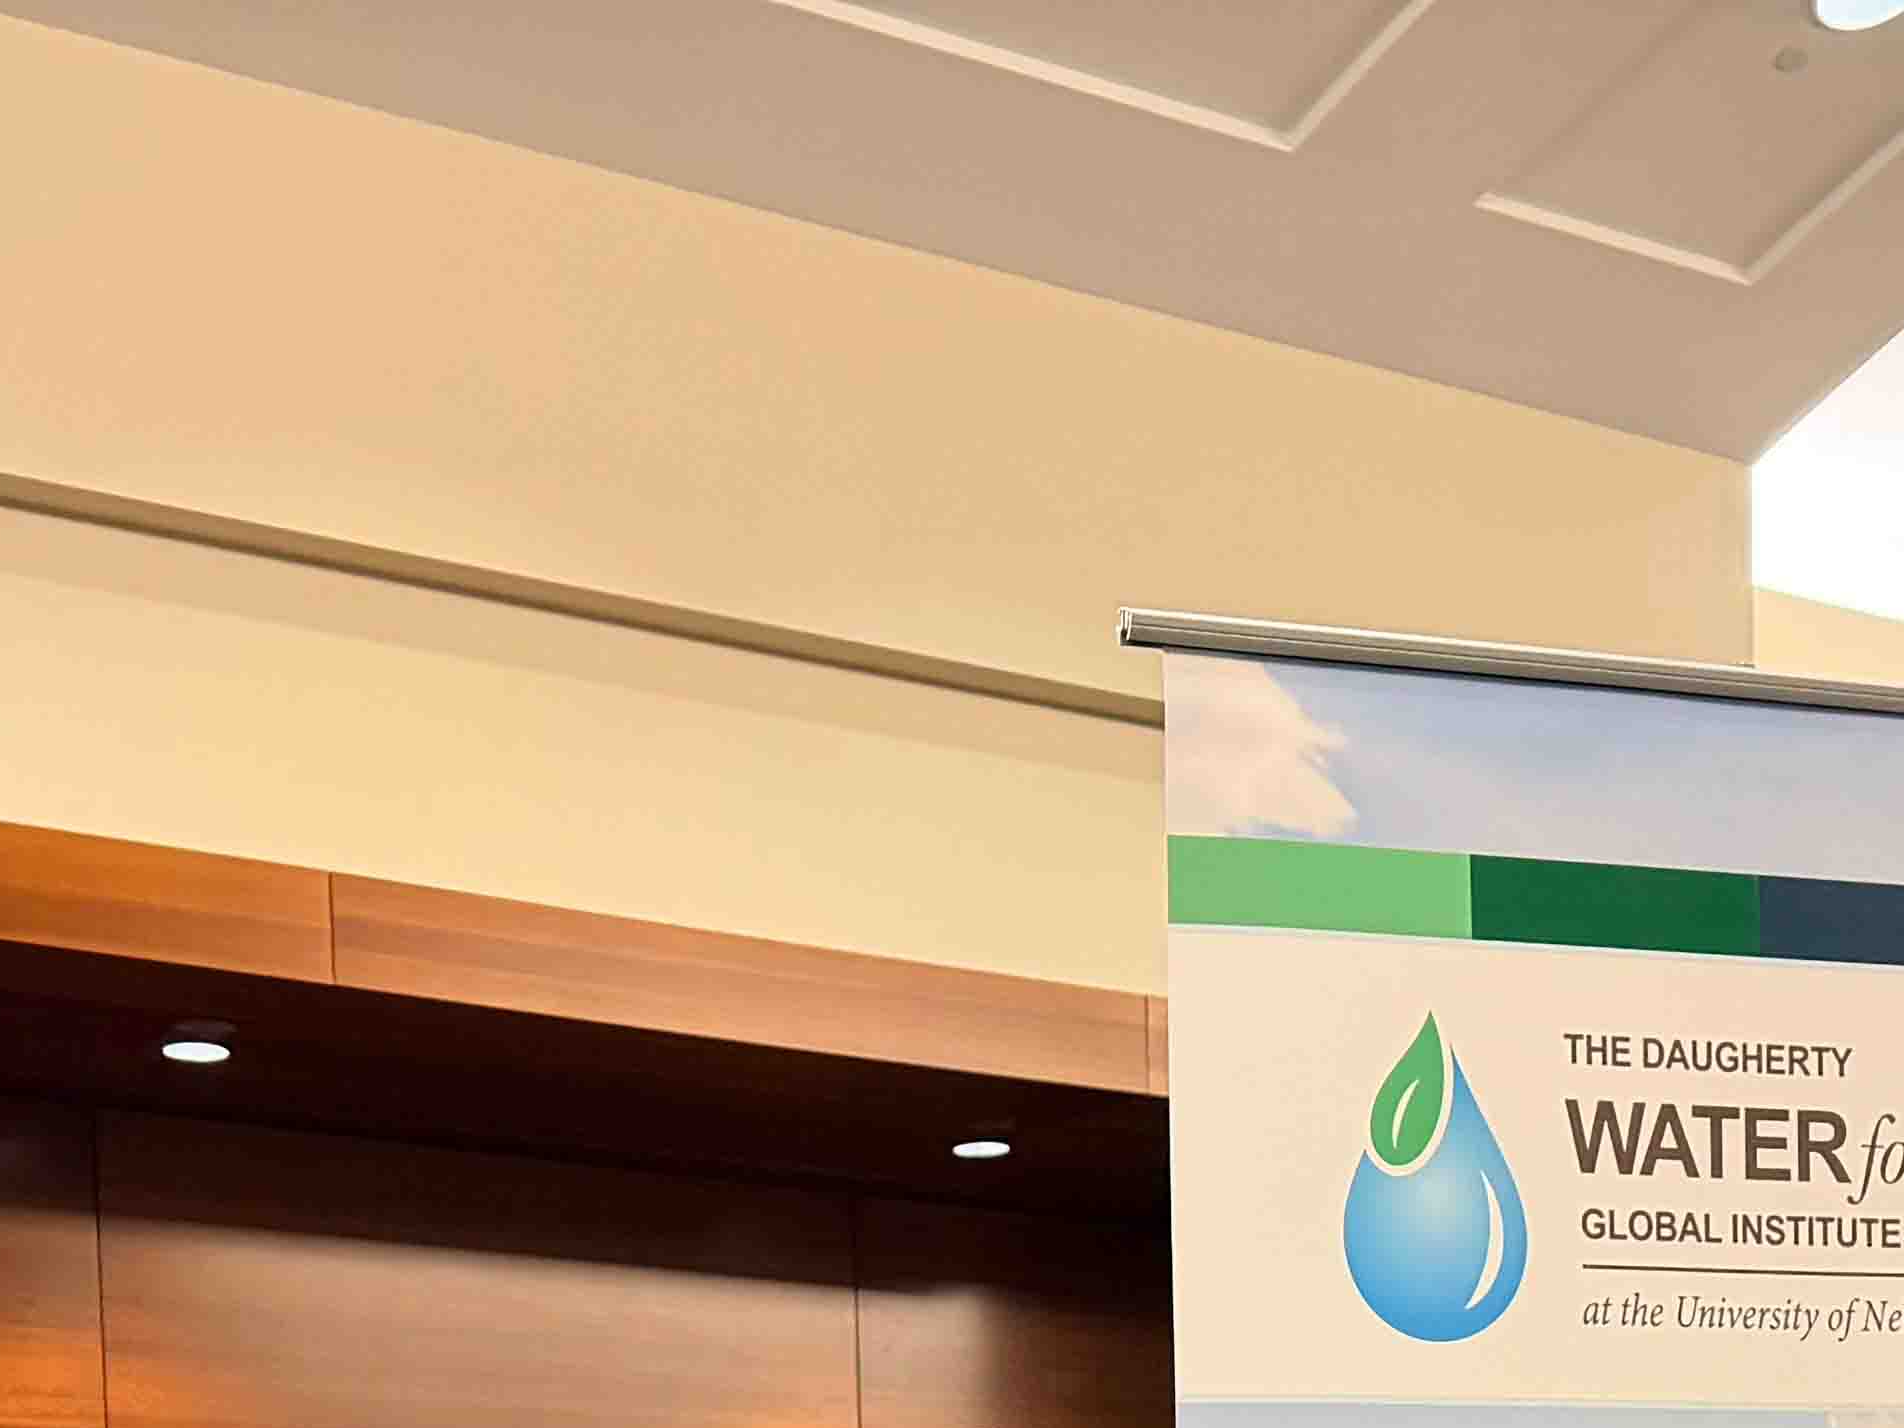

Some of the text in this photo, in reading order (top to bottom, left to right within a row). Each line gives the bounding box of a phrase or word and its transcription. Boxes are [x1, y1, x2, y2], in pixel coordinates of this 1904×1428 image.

[1564, 1033, 1852, 1078] THE DAUGHERTY
[1564, 1100, 1851, 1184] WATER
[1581, 1210, 1902, 1249] GLOBAL INSTITUTE
[1583, 1297, 1611, 1328] at
[1618, 1292, 1664, 1328] the
[1677, 1295, 1819, 1341] University
[1827, 1299, 1860, 1337] of
